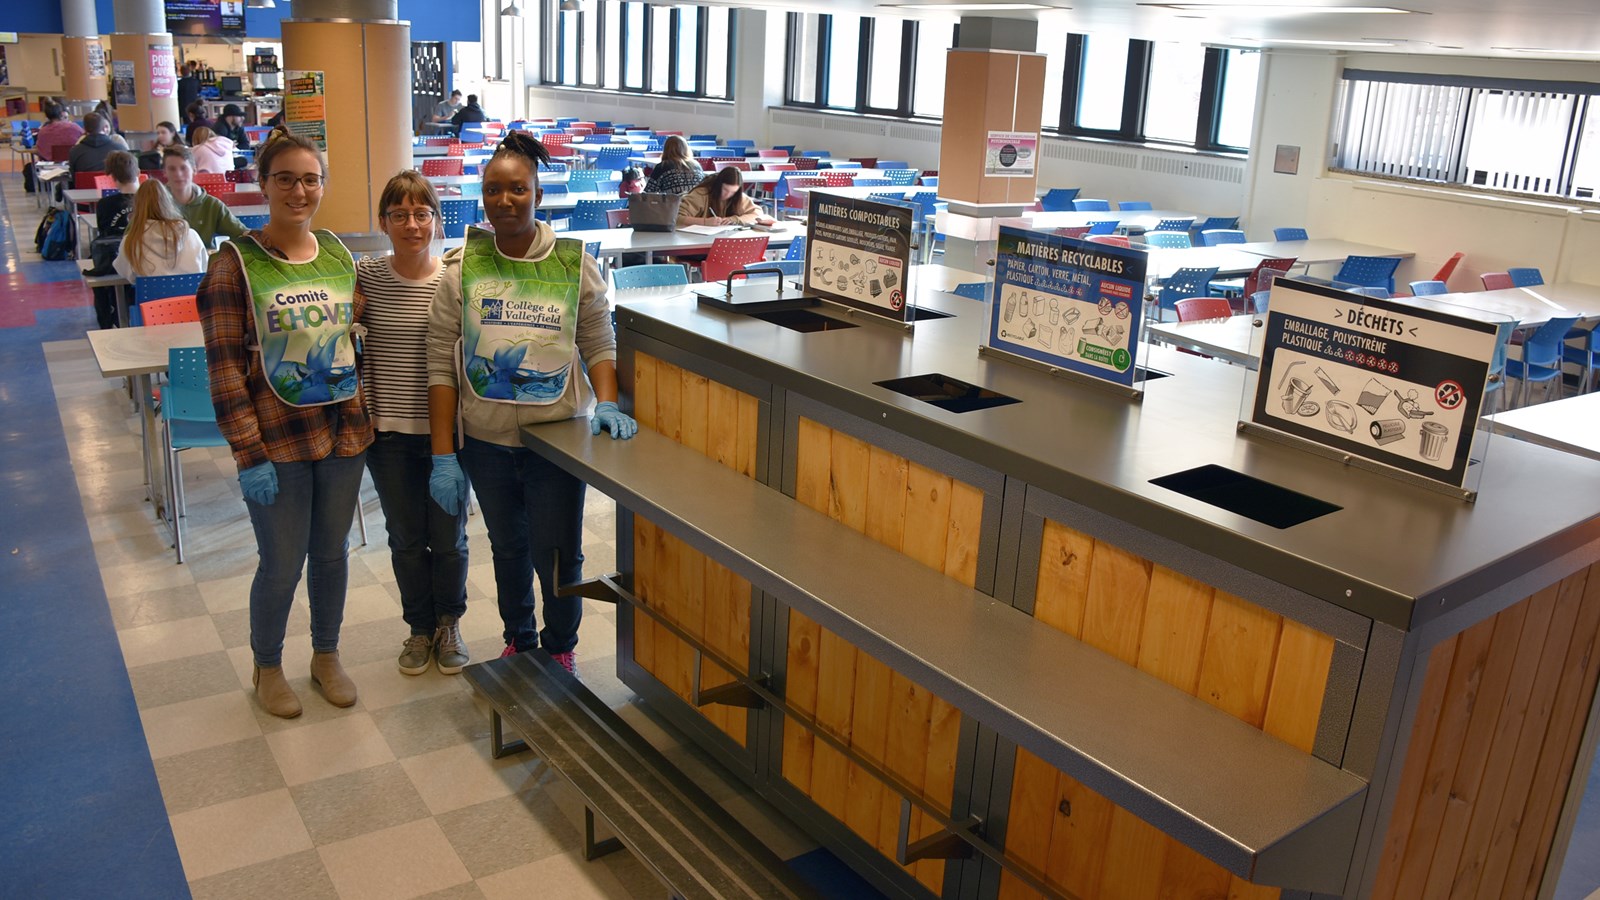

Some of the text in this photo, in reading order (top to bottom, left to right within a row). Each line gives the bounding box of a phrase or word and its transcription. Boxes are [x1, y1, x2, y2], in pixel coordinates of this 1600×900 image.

[818, 202, 900, 229] MATIÈRES COMPOSTABLES
[1016, 241, 1059, 261] MATIÈRES
[1061, 249, 1124, 274] RECYCLABLES
[1006, 270, 1034, 285] PLASTIQUE
[1007, 259, 1092, 287] PAPIER, CARTON, VERRE, MÉTAL,
[275, 289, 329, 306] Comité
[1100, 282, 1131, 293] AUCUN LIQUIDE
[505, 310, 561, 324] Valleyfield
[506, 300, 560, 314] Collège de
[1347, 307, 1404, 336] DÉCHETS
[1281, 332, 1323, 353] PLASTIQUE
[1283, 319, 1387, 354] EMBALLAGE, POLYSTYRÈNE
